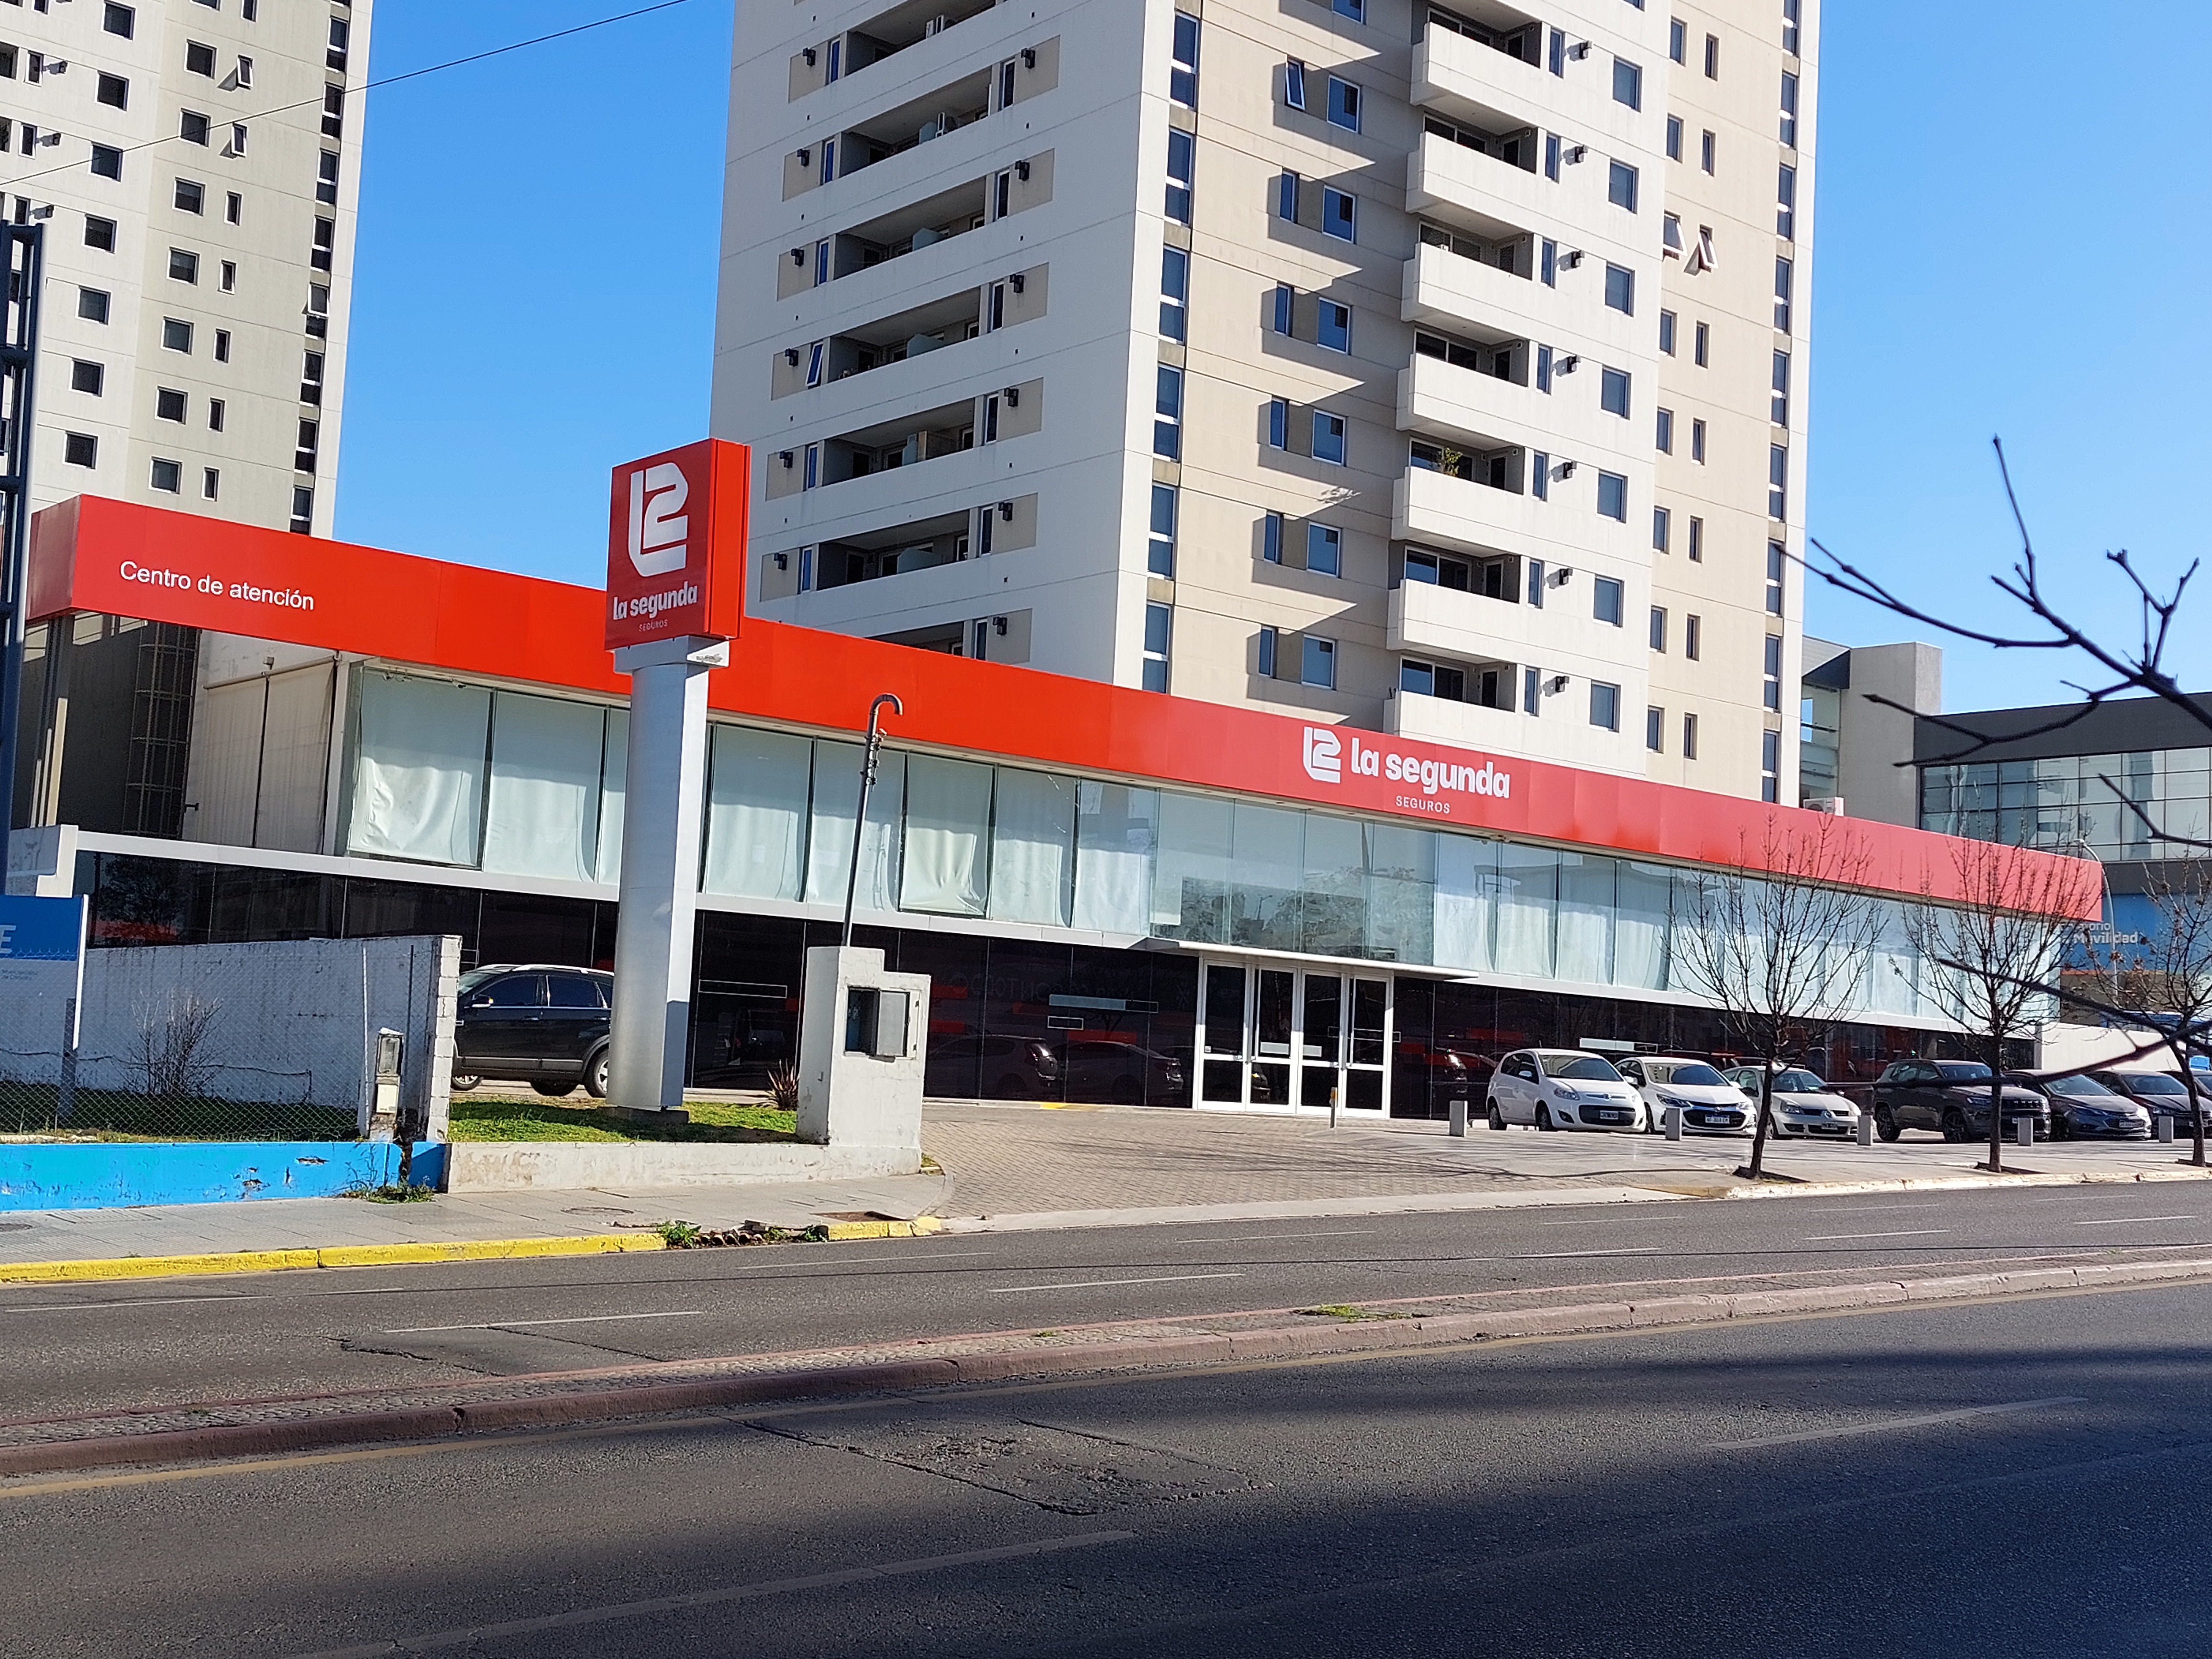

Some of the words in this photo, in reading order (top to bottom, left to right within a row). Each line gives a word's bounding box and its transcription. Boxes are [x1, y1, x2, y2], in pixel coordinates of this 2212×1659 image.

[120, 561, 191, 589] Centro
[197, 574, 223, 595] de
[229, 582, 314, 610] atención
[613, 597, 628, 620] la
[630, 581, 697, 619] segunda
[639, 619, 668, 632] SEGUROS
[1351, 737, 1379, 777] la
[1385, 753, 1510, 798] segunda
[1396, 796, 1450, 814] SEGUROS
[2074, 931, 2138, 944] Mvilidad
